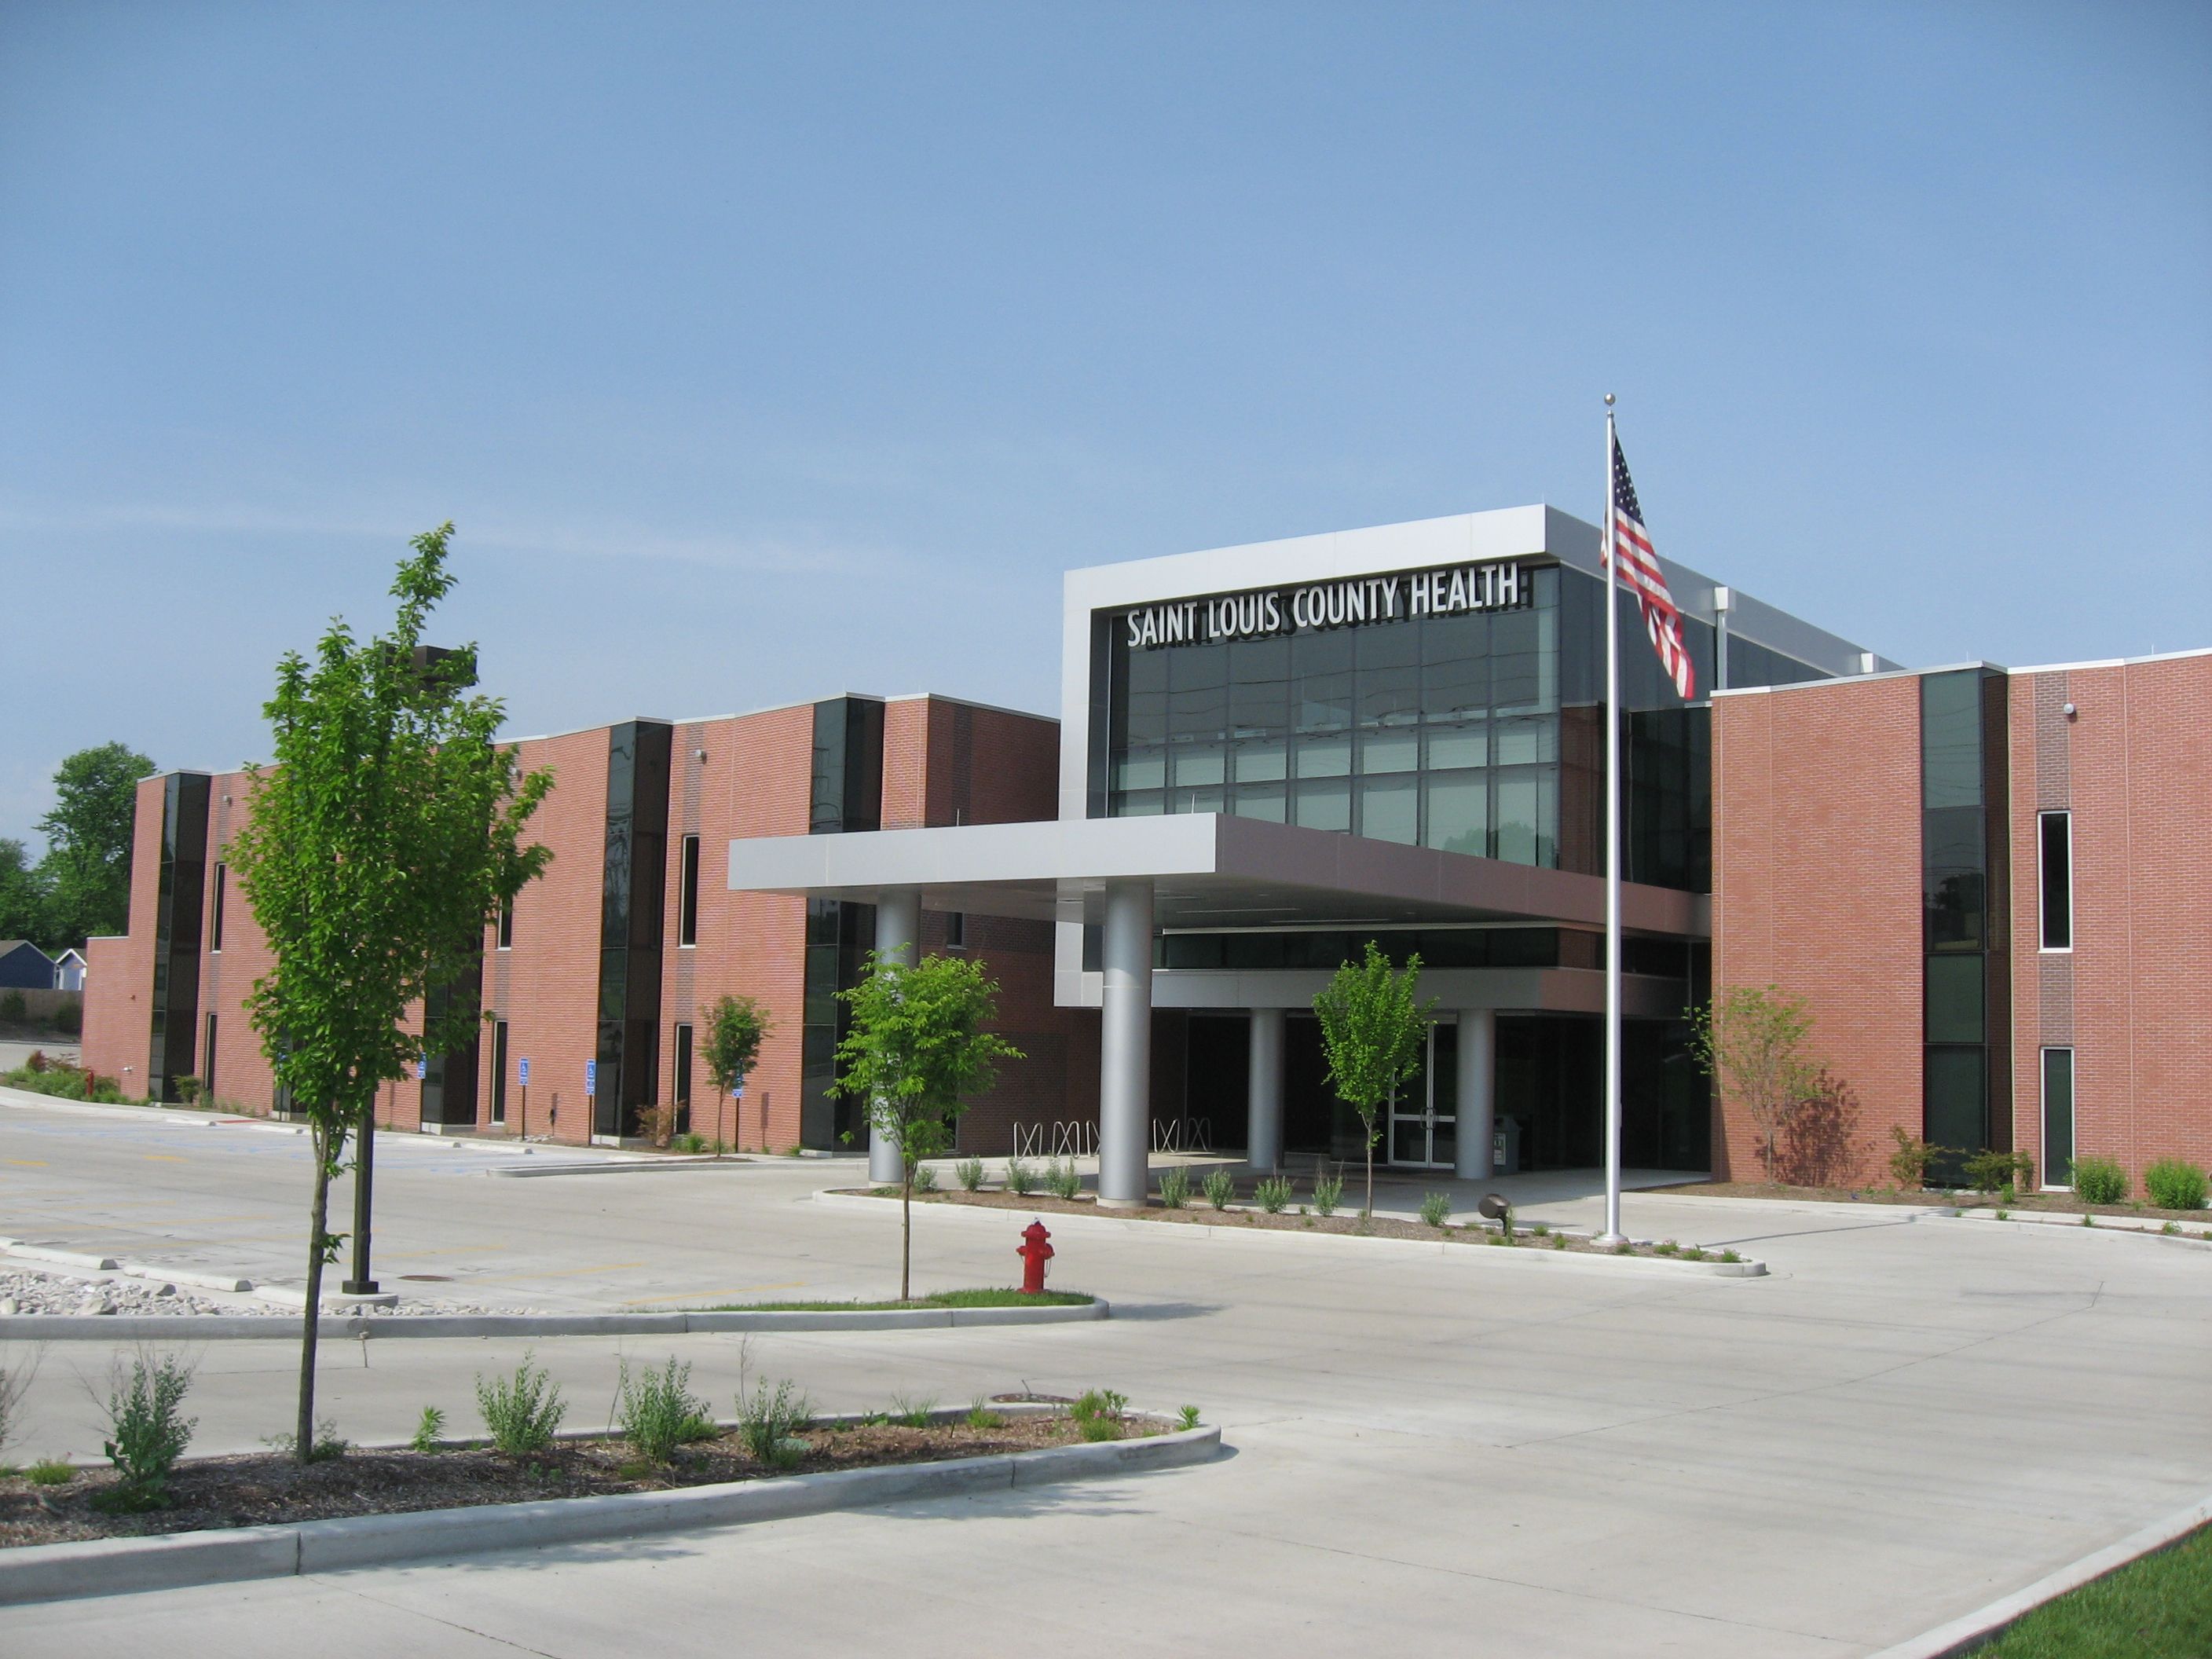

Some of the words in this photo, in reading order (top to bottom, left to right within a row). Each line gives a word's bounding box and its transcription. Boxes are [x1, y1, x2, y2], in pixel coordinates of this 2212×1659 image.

[1127, 602, 1197, 646] SAINT
[1209, 591, 1280, 638] LOUIS
[1294, 577, 1399, 627] COUNTY
[1412, 563, 1518, 614] HEALTH
